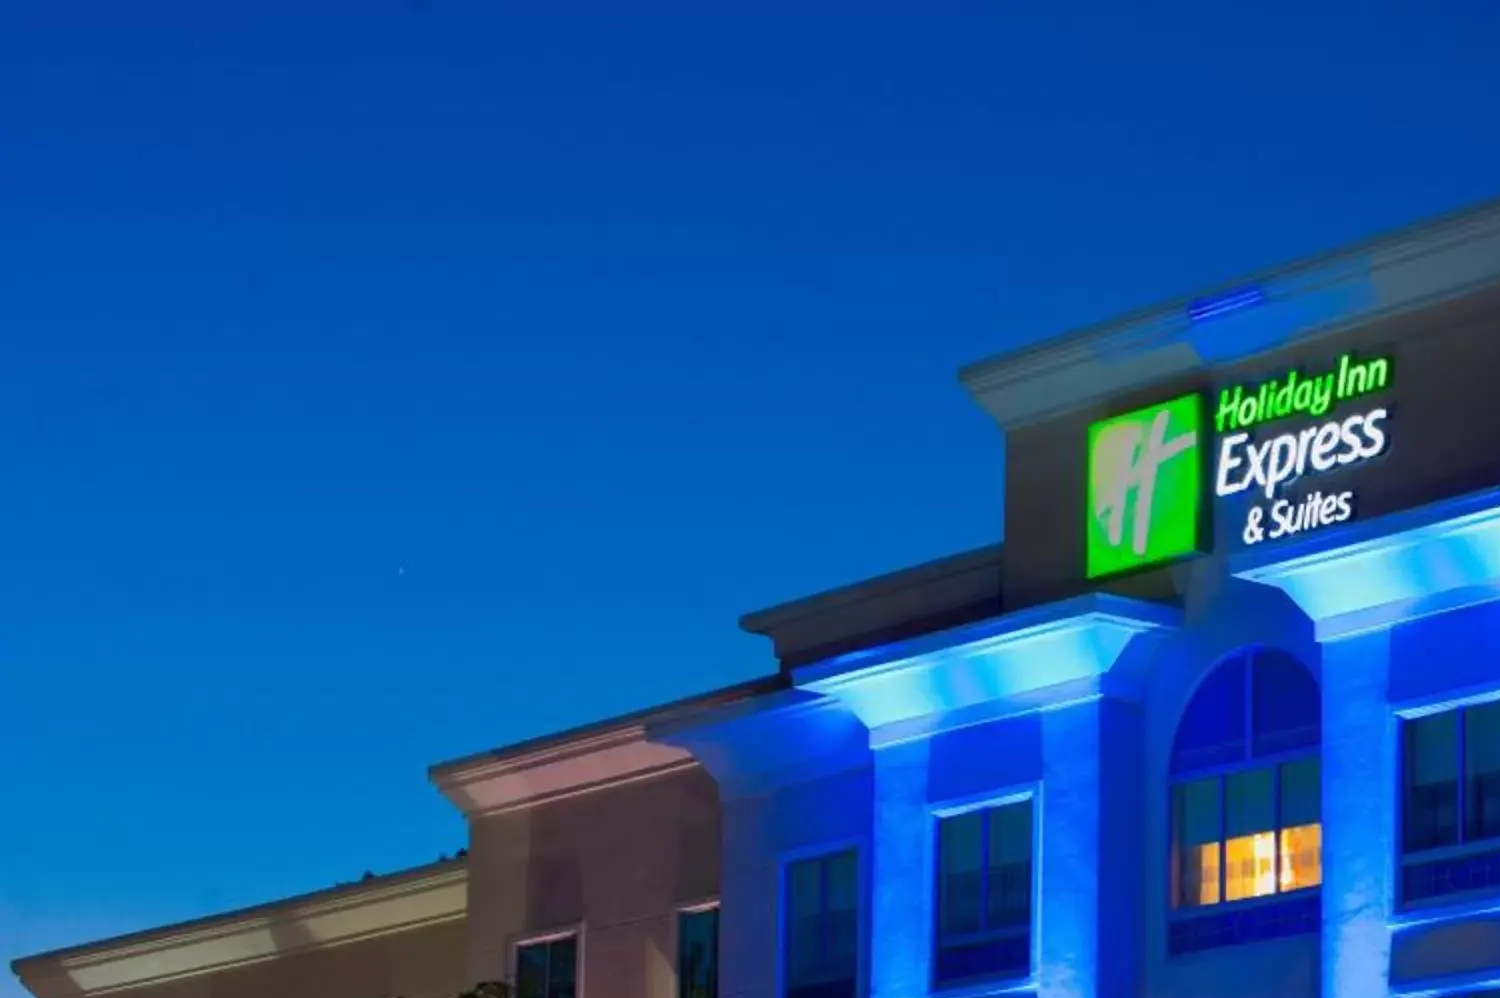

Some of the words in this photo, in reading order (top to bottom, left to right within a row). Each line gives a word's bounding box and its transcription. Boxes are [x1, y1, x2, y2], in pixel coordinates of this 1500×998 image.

[1216, 371, 1334, 432] Holiday
[1337, 355, 1388, 399] Inn
[1216, 409, 1388, 499] Express
[1243, 506, 1265, 545] &
[1269, 491, 1352, 539] Suites
